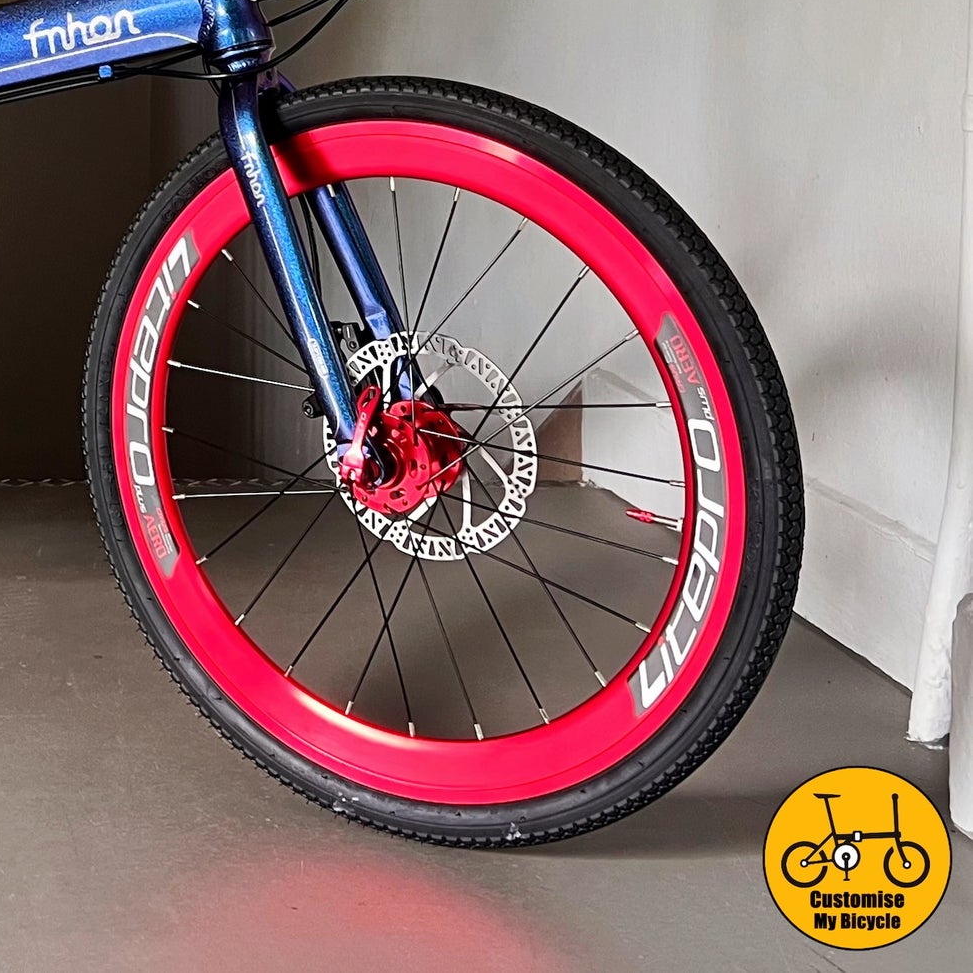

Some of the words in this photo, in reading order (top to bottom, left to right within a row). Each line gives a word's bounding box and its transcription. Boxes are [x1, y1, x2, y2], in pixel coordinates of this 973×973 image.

[23, 9, 141, 58] fnhon
[127, 237, 191, 486] Litepro
[669, 335, 701, 384] AERO
[143, 514, 168, 559] AERO
[638, 418, 725, 709] Litepro
